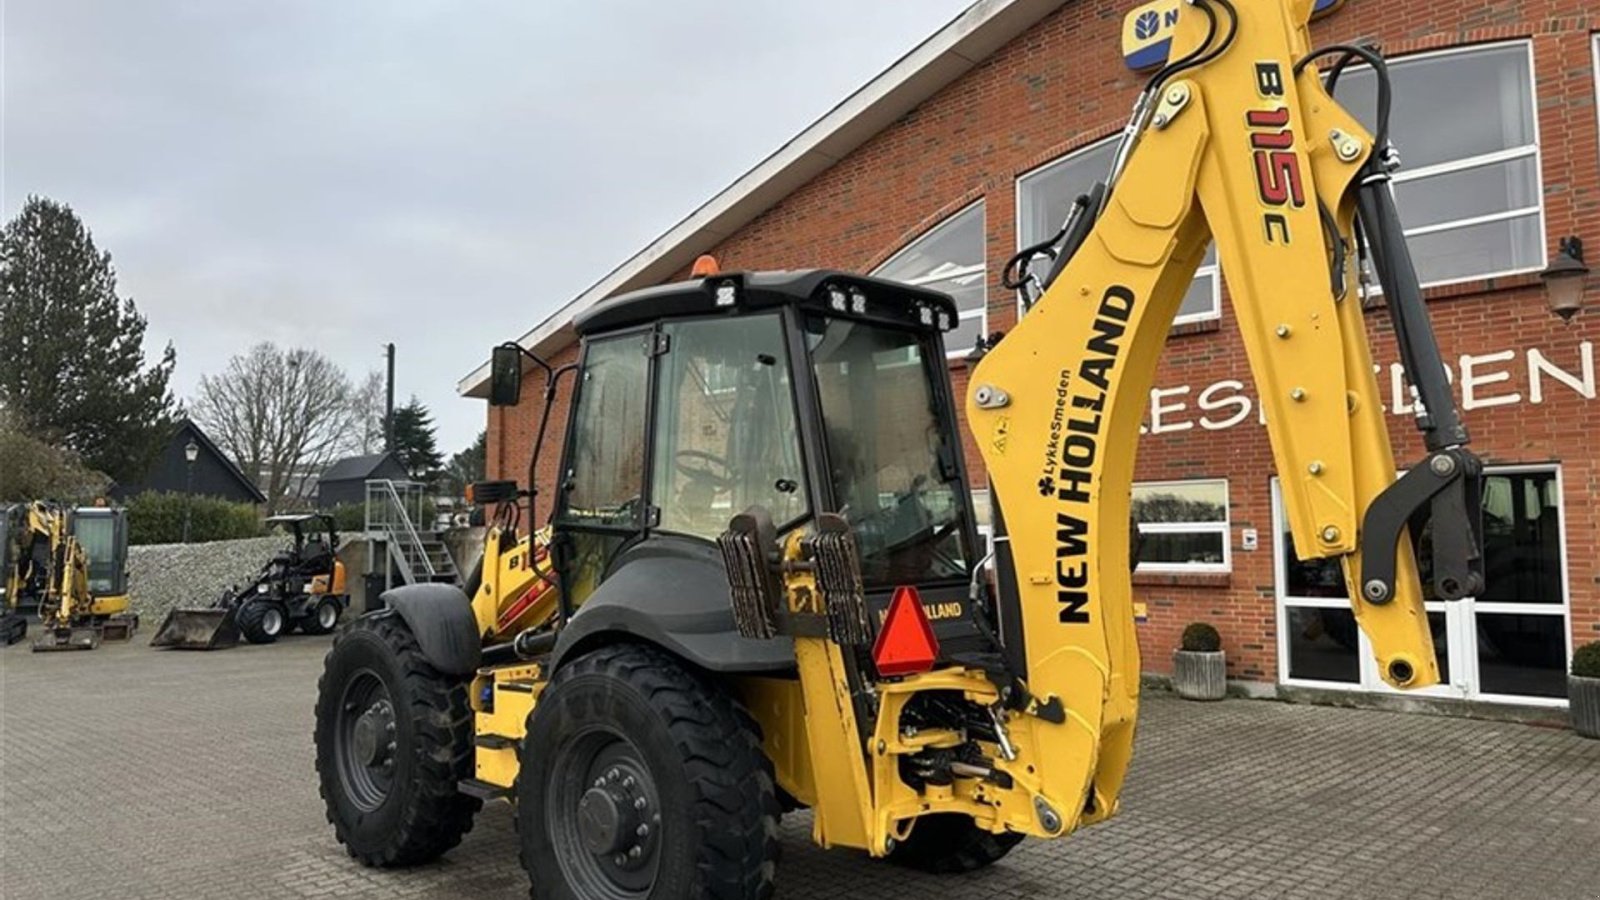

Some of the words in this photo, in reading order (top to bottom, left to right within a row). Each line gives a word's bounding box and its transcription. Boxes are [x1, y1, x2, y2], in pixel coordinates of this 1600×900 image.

[1255, 62, 1284, 96] B
[1247, 107, 1305, 208] 115
[1043, 369, 1071, 475] LykkeSmeden
[1058, 284, 1135, 503] HOLLAND
[1056, 512, 1090, 624] NEW
